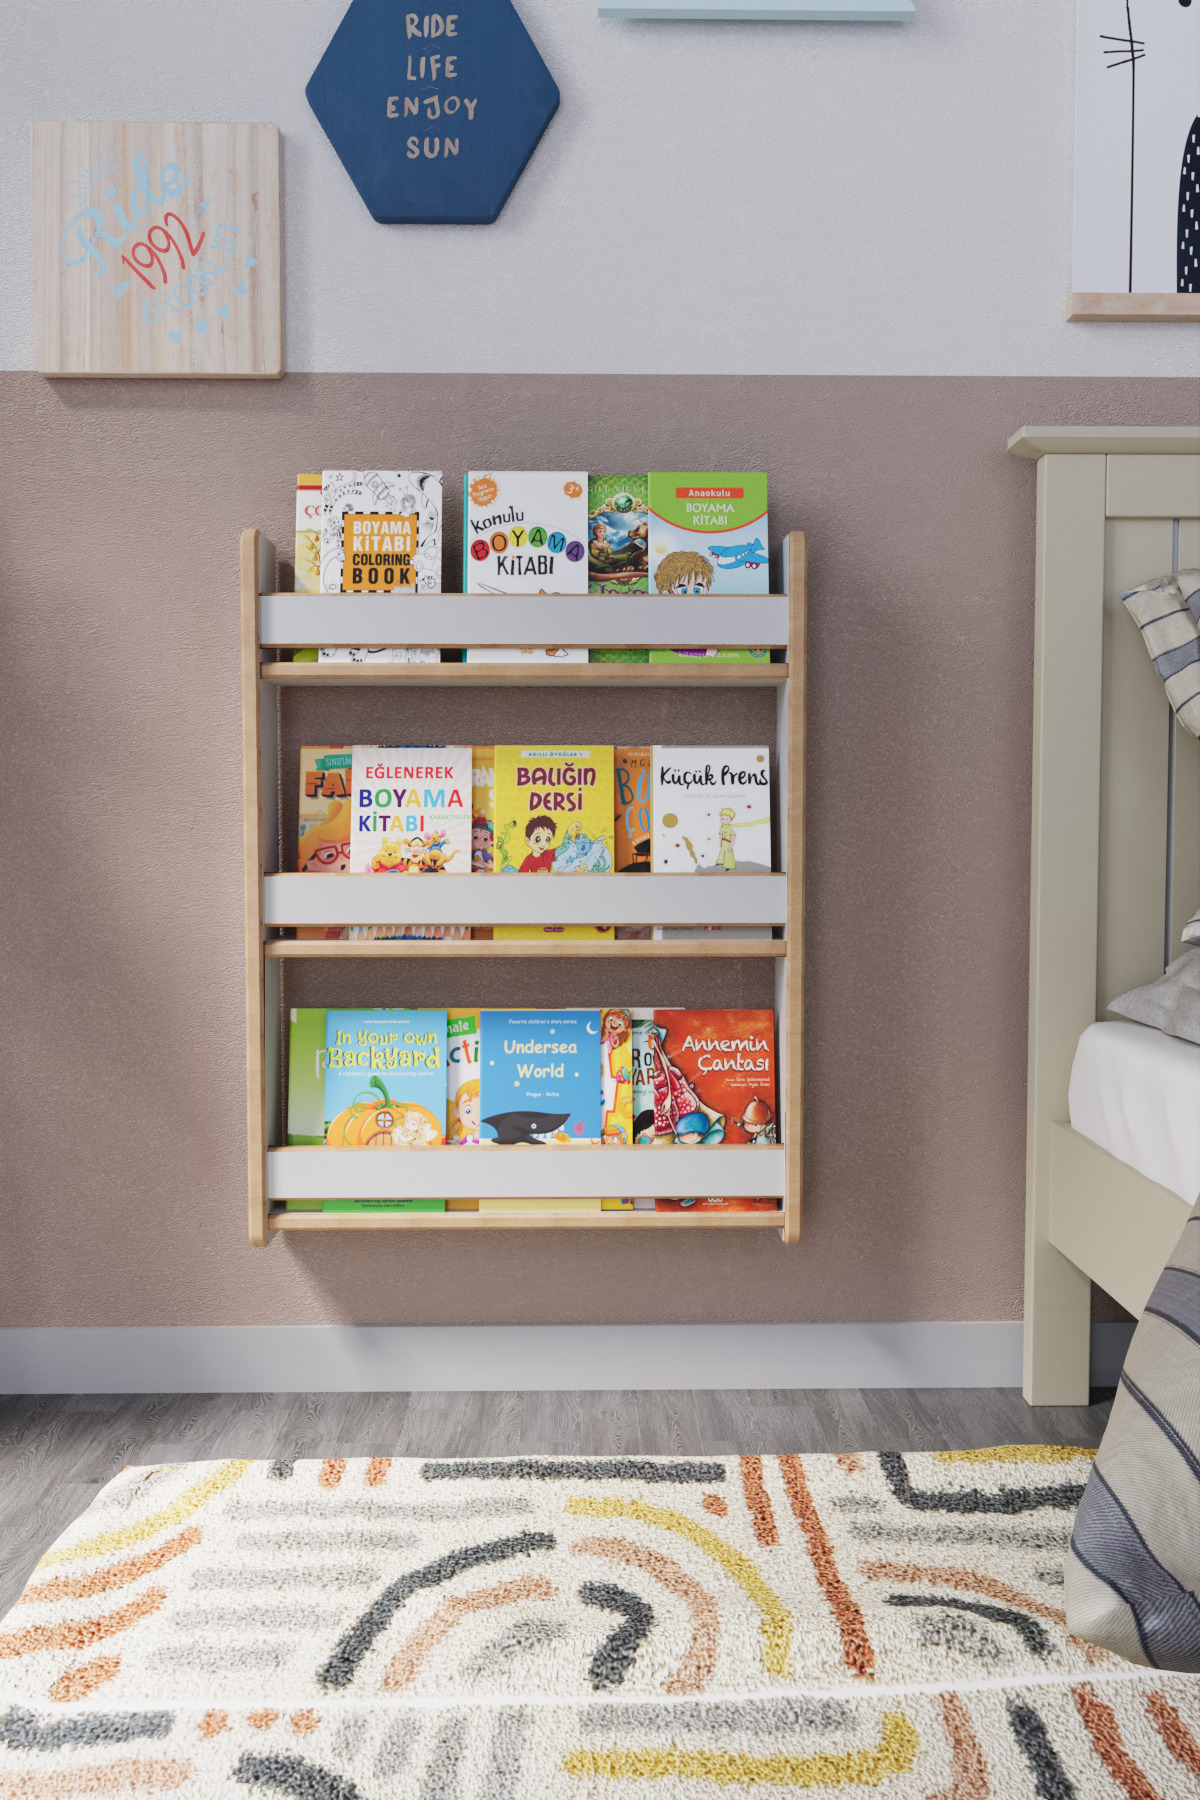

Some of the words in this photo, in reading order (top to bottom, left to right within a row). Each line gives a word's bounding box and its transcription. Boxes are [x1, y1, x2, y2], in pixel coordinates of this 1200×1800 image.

[405, 13, 458, 39] RIDE
[406, 54, 458, 81] LIFE
[386, 95, 478, 120] ENJOY
[406, 136, 460, 159] SUN
[61, 151, 192, 277] Ride
[121, 212, 206, 290] 1992
[688, 488, 731, 497] Anaokulu
[686, 502, 735, 513] BOYAMA
[352, 520, 412, 535] BOYAMA
[472, 528, 580, 561] BOYAMA
[352, 553, 411, 566] COLORING
[352, 568, 411, 584] BOOK
[365, 763, 454, 779] EĞLENEREK
[660, 764, 717, 790] Küçük
[720, 764, 769, 786] Prens
[359, 788, 464, 808] BOYAMA
[336, 1030, 352, 1046] In
[504, 1039, 578, 1055] Undersea
[681, 1035, 770, 1052] Annemin
[327, 1045, 441, 1070] Backyard
[447, 1040, 479, 1066] cti
[517, 1062, 565, 1078] World
[697, 1053, 770, 1075] Çantası
